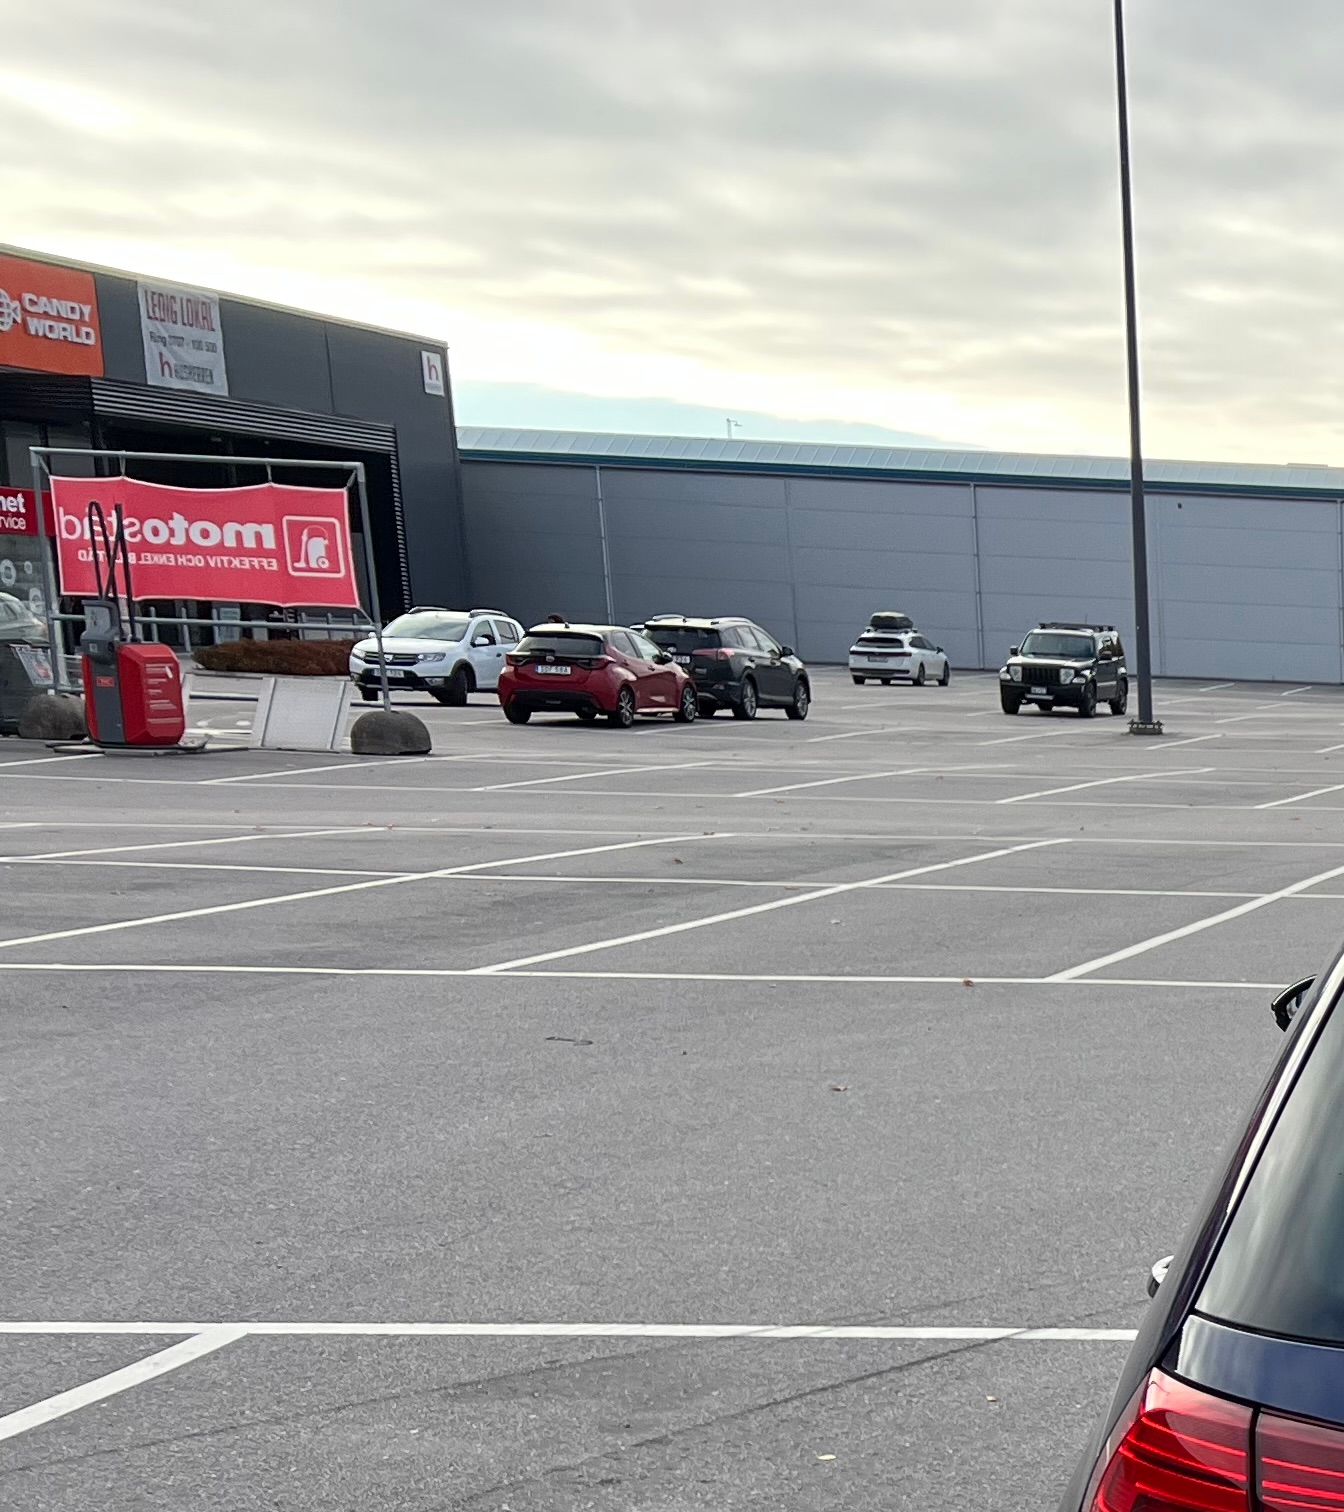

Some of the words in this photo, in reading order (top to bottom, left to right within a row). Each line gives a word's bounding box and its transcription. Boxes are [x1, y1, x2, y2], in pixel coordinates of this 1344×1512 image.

[21, 292, 92, 322] CANDY
[145, 290, 178, 325] LEDIG
[181, 297, 215, 332] LOKAL
[26, 316, 96, 345] WORLD
